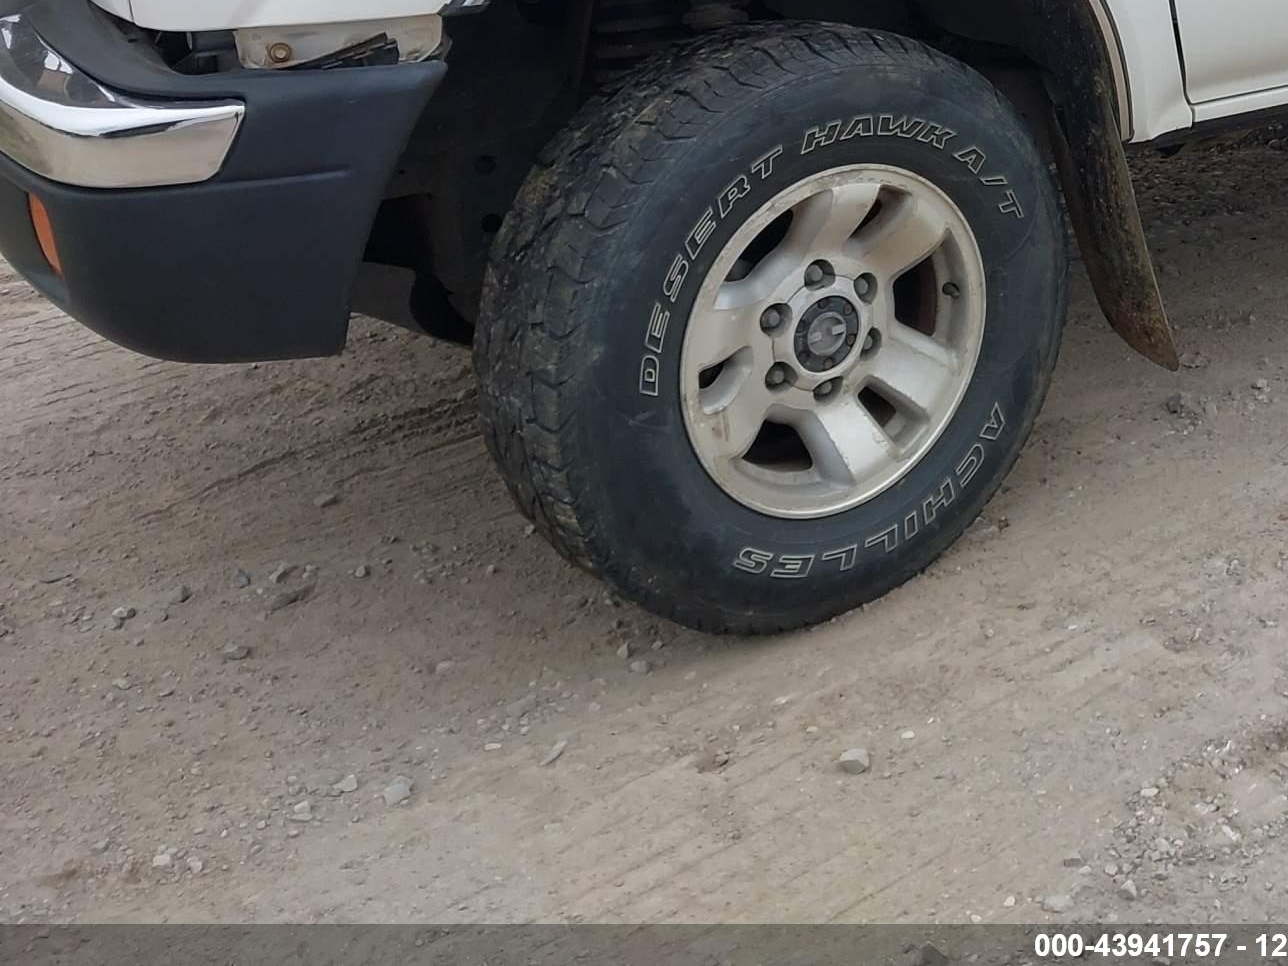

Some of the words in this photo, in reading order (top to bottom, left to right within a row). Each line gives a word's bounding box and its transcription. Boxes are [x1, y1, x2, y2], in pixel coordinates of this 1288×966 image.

[638, 144, 785, 397] DESERT
[800, 113, 958, 156] HAWK
[953, 146, 1026, 220] A/T
[732, 401, 1007, 580] ACHILLES
